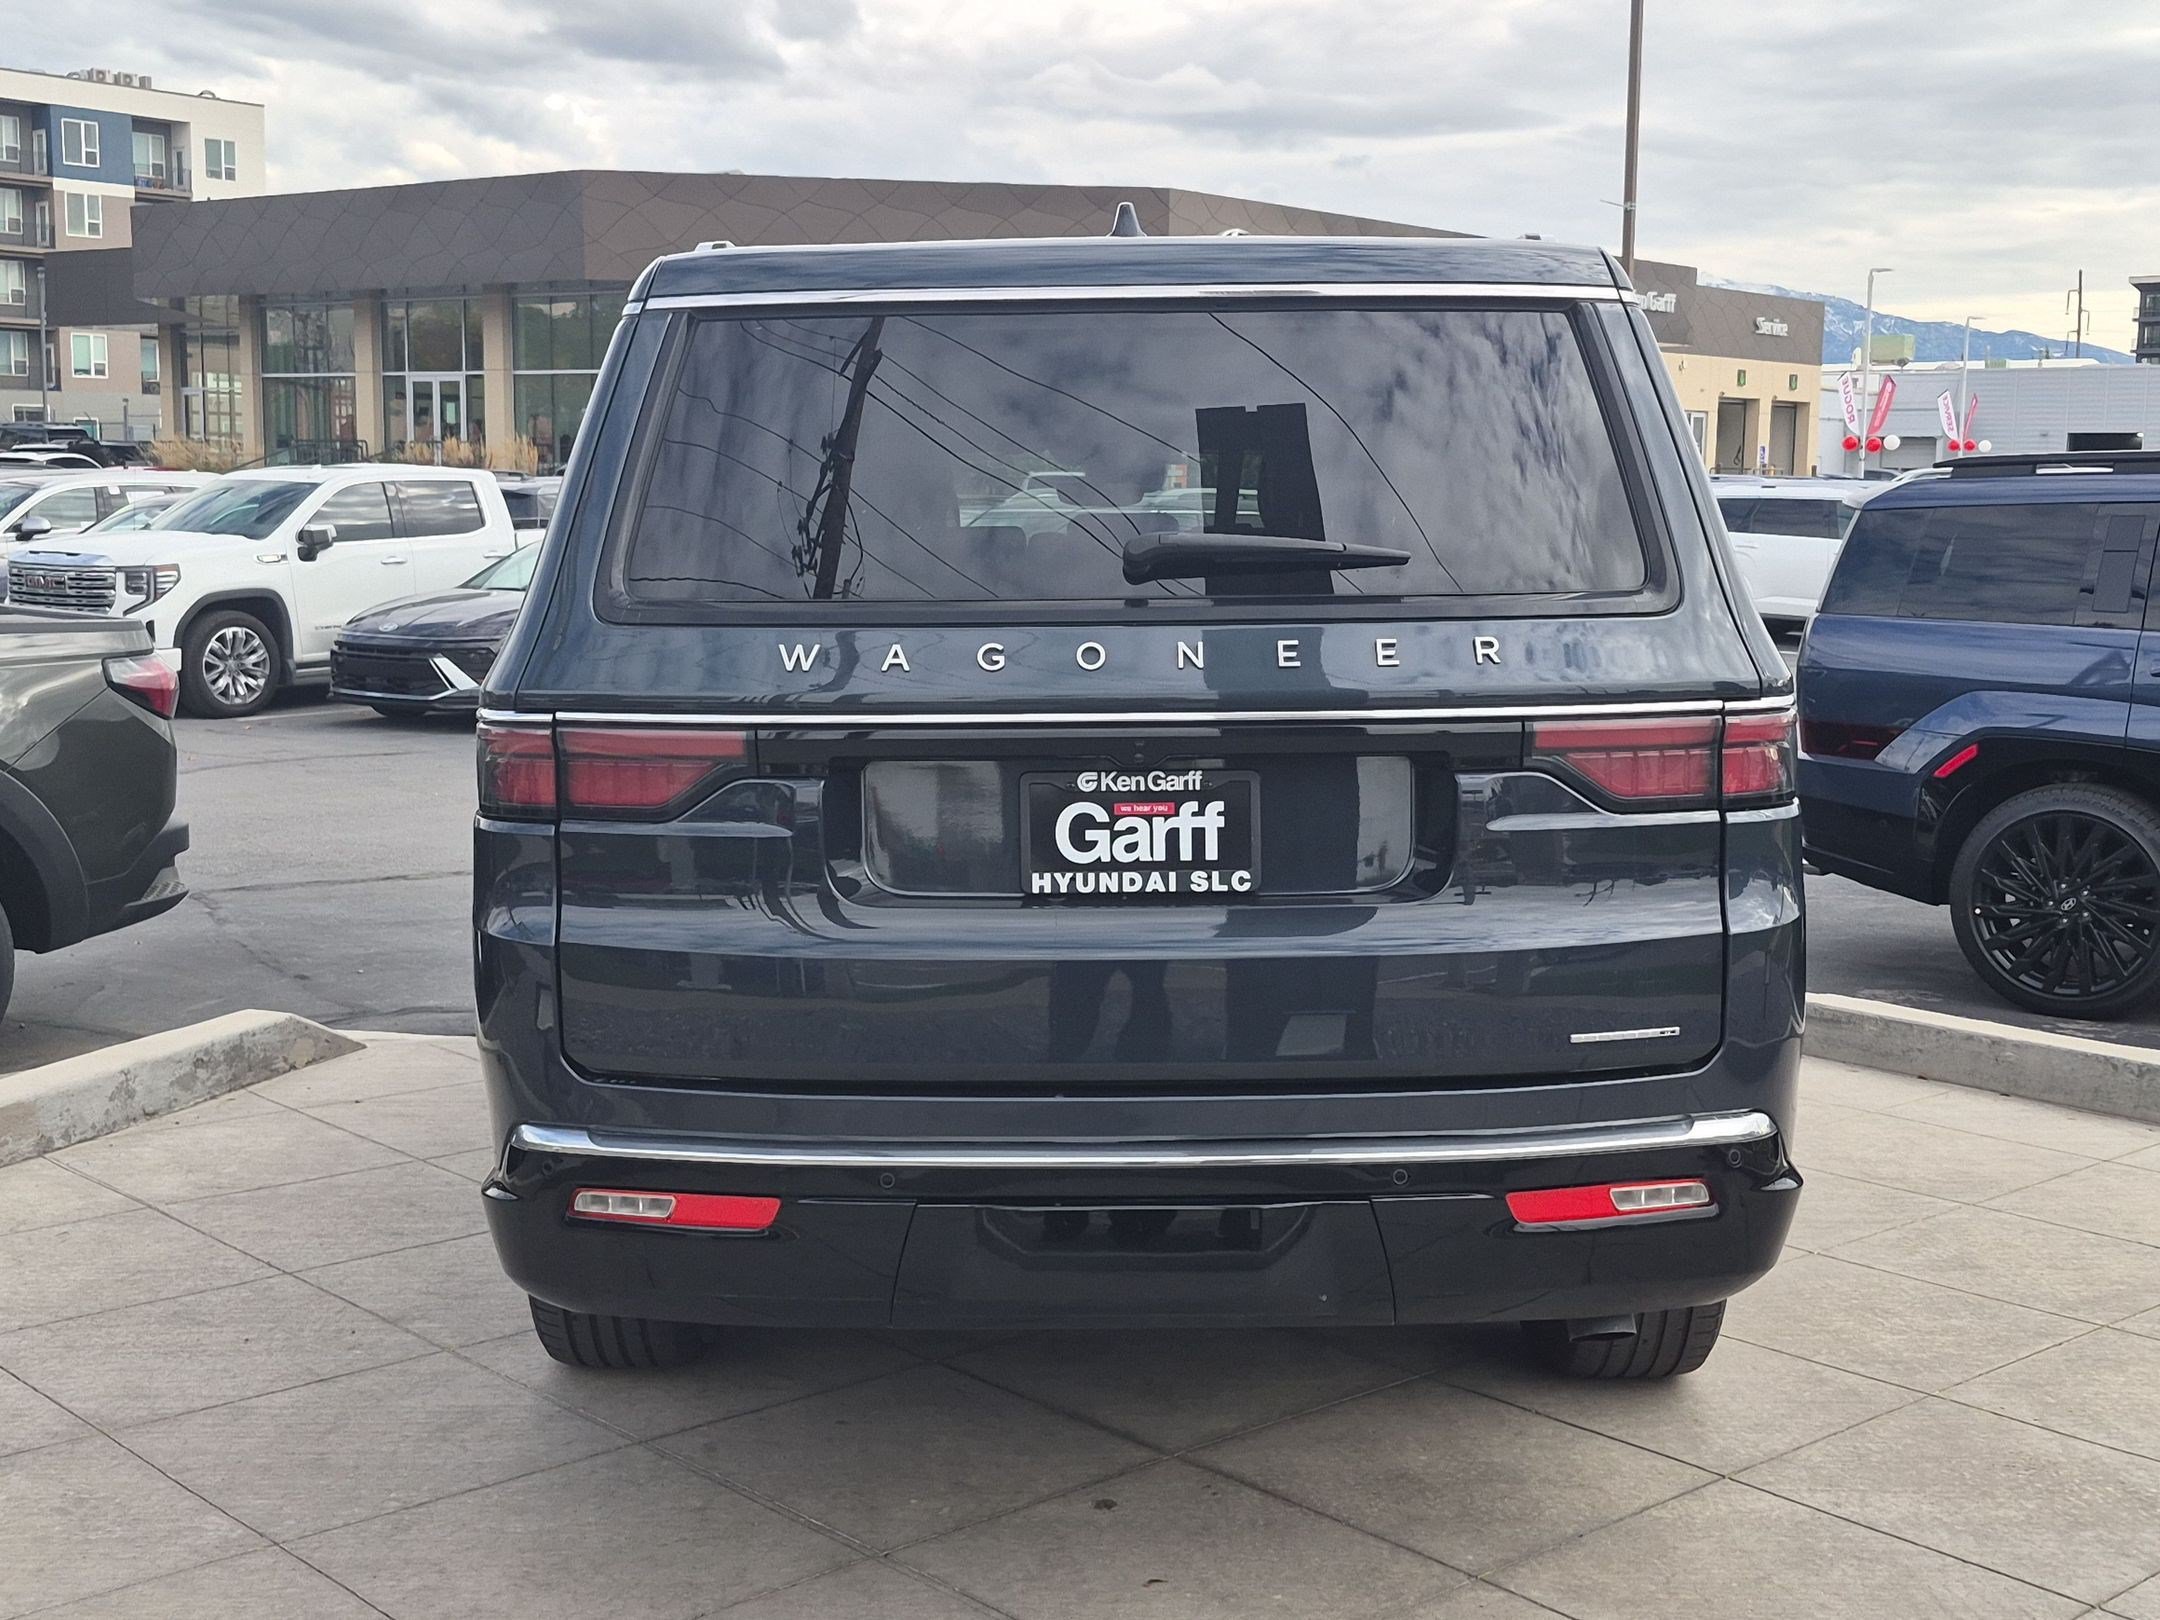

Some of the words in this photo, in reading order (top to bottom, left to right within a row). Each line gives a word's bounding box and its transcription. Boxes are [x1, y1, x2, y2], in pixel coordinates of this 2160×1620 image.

[1755, 316, 1790, 337] Service
[778, 635, 1502, 672] WAGONEER
[1100, 771, 1145, 792] Ken
[1147, 770, 1203, 792] Garff
[1133, 804, 1152, 812] hear
[1153, 804, 1169, 813] you
[1055, 800, 1225, 865] Garff
[1031, 871, 1177, 894] HYUNDAI
[1190, 871, 1252, 892] SLC
